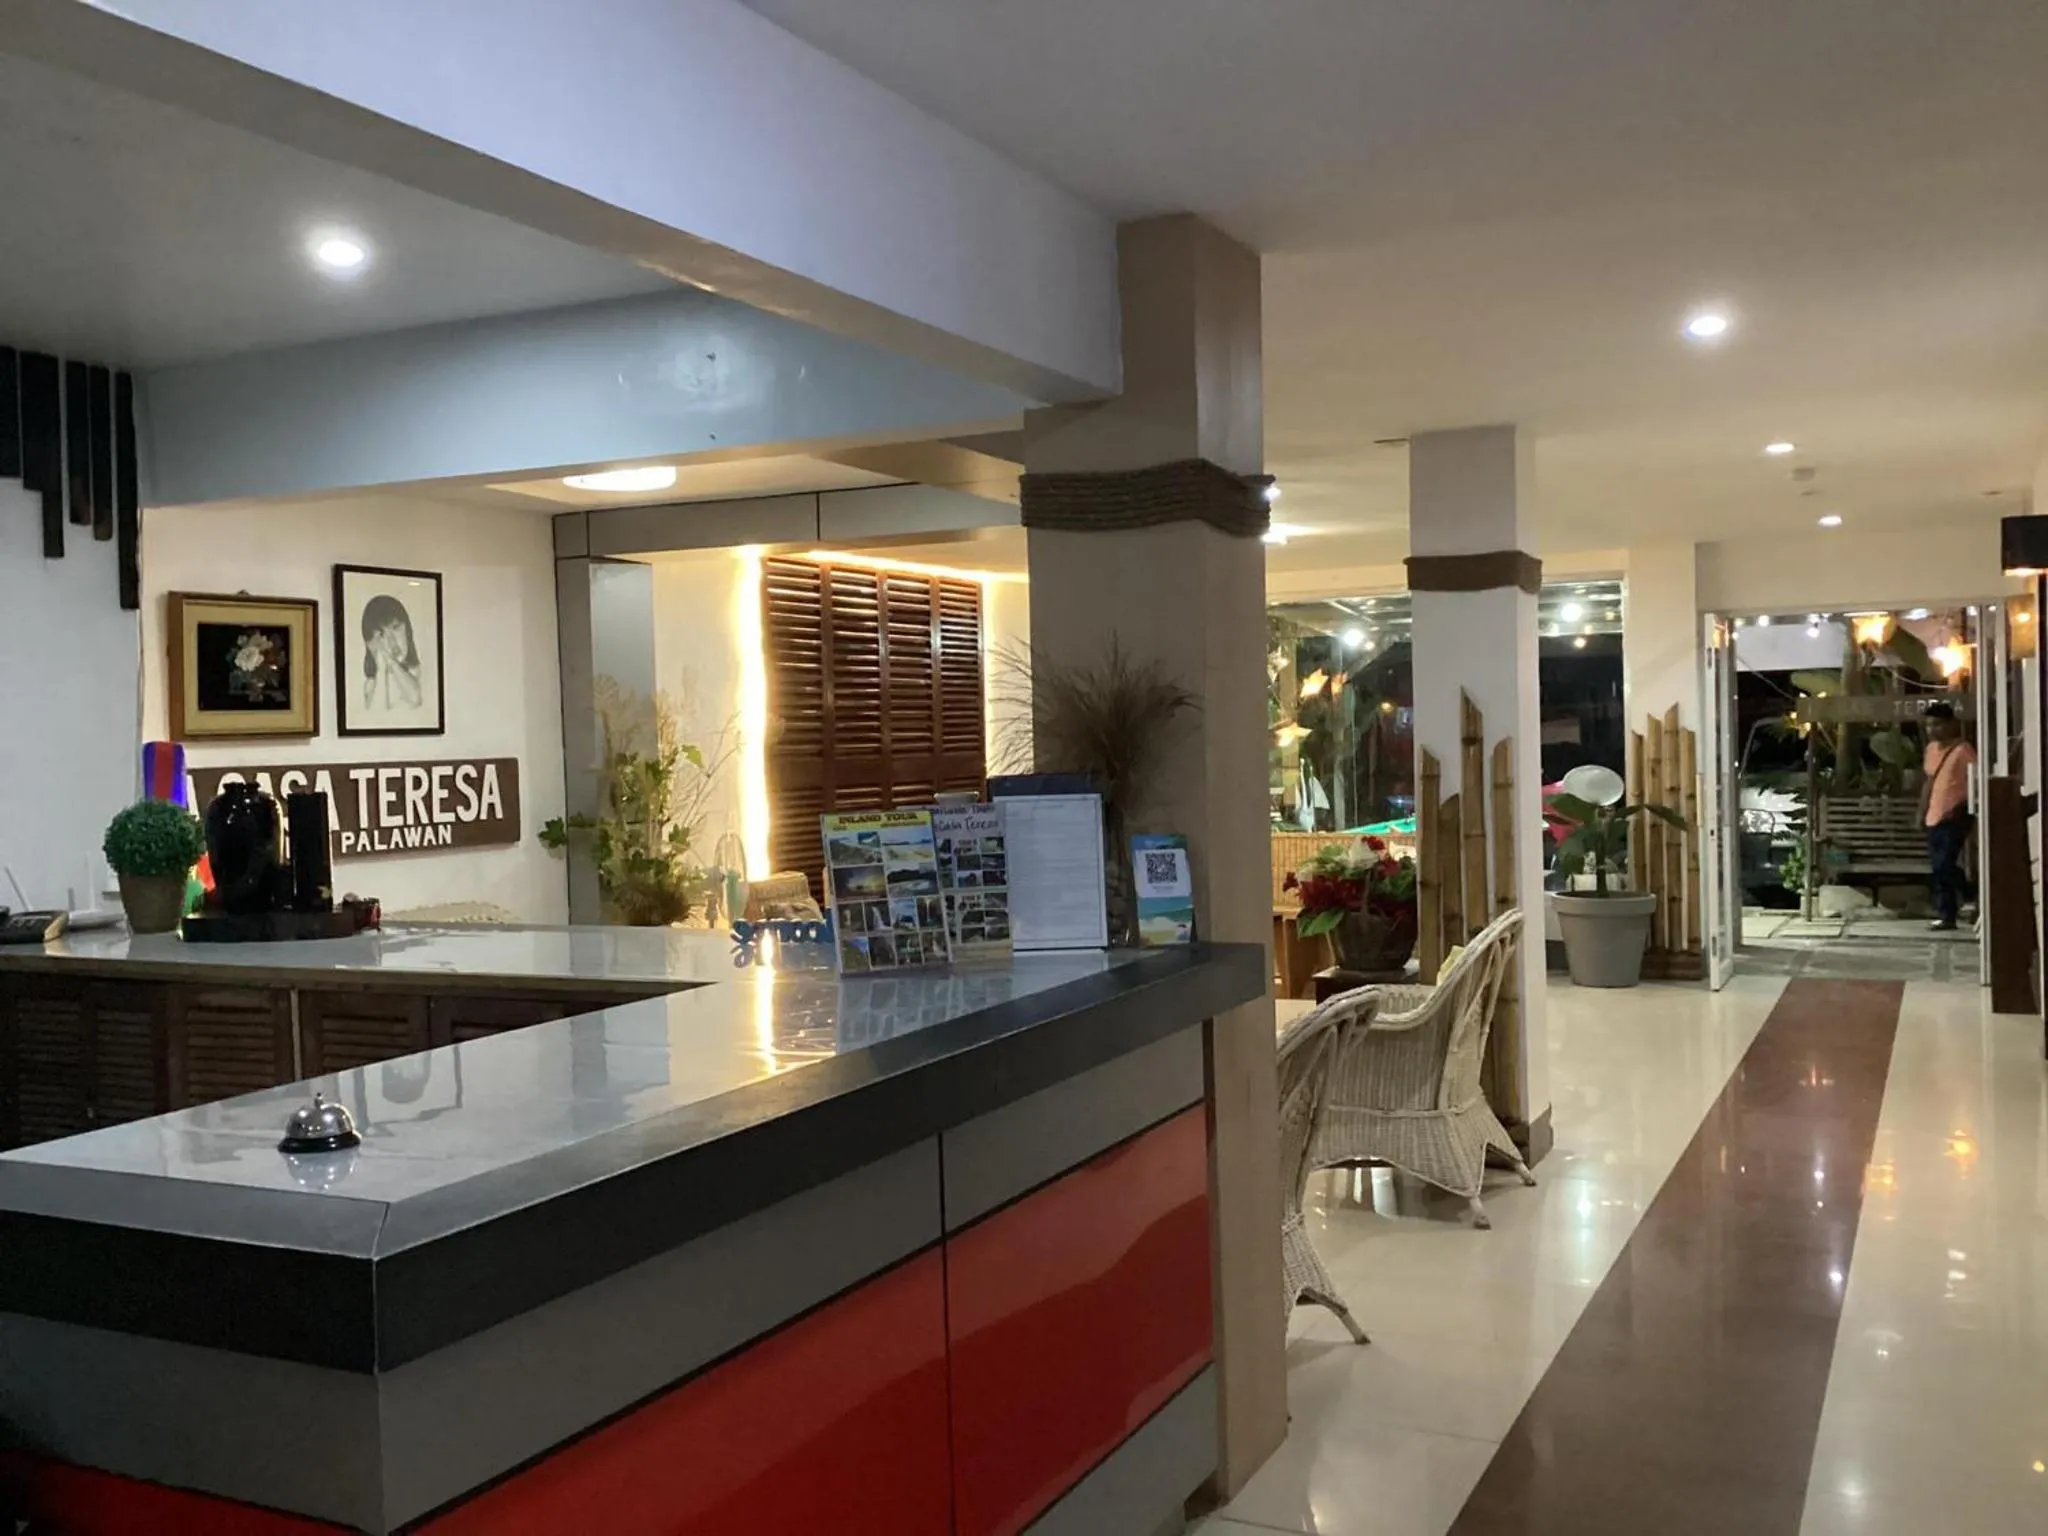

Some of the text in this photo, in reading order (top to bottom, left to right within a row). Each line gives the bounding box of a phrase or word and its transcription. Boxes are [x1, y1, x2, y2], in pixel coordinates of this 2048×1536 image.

[1893, 698, 1965, 716] TERA
[217, 770, 340, 831] SA
[349, 764, 504, 829] TERESA
[341, 824, 452, 854] PALAWAN
